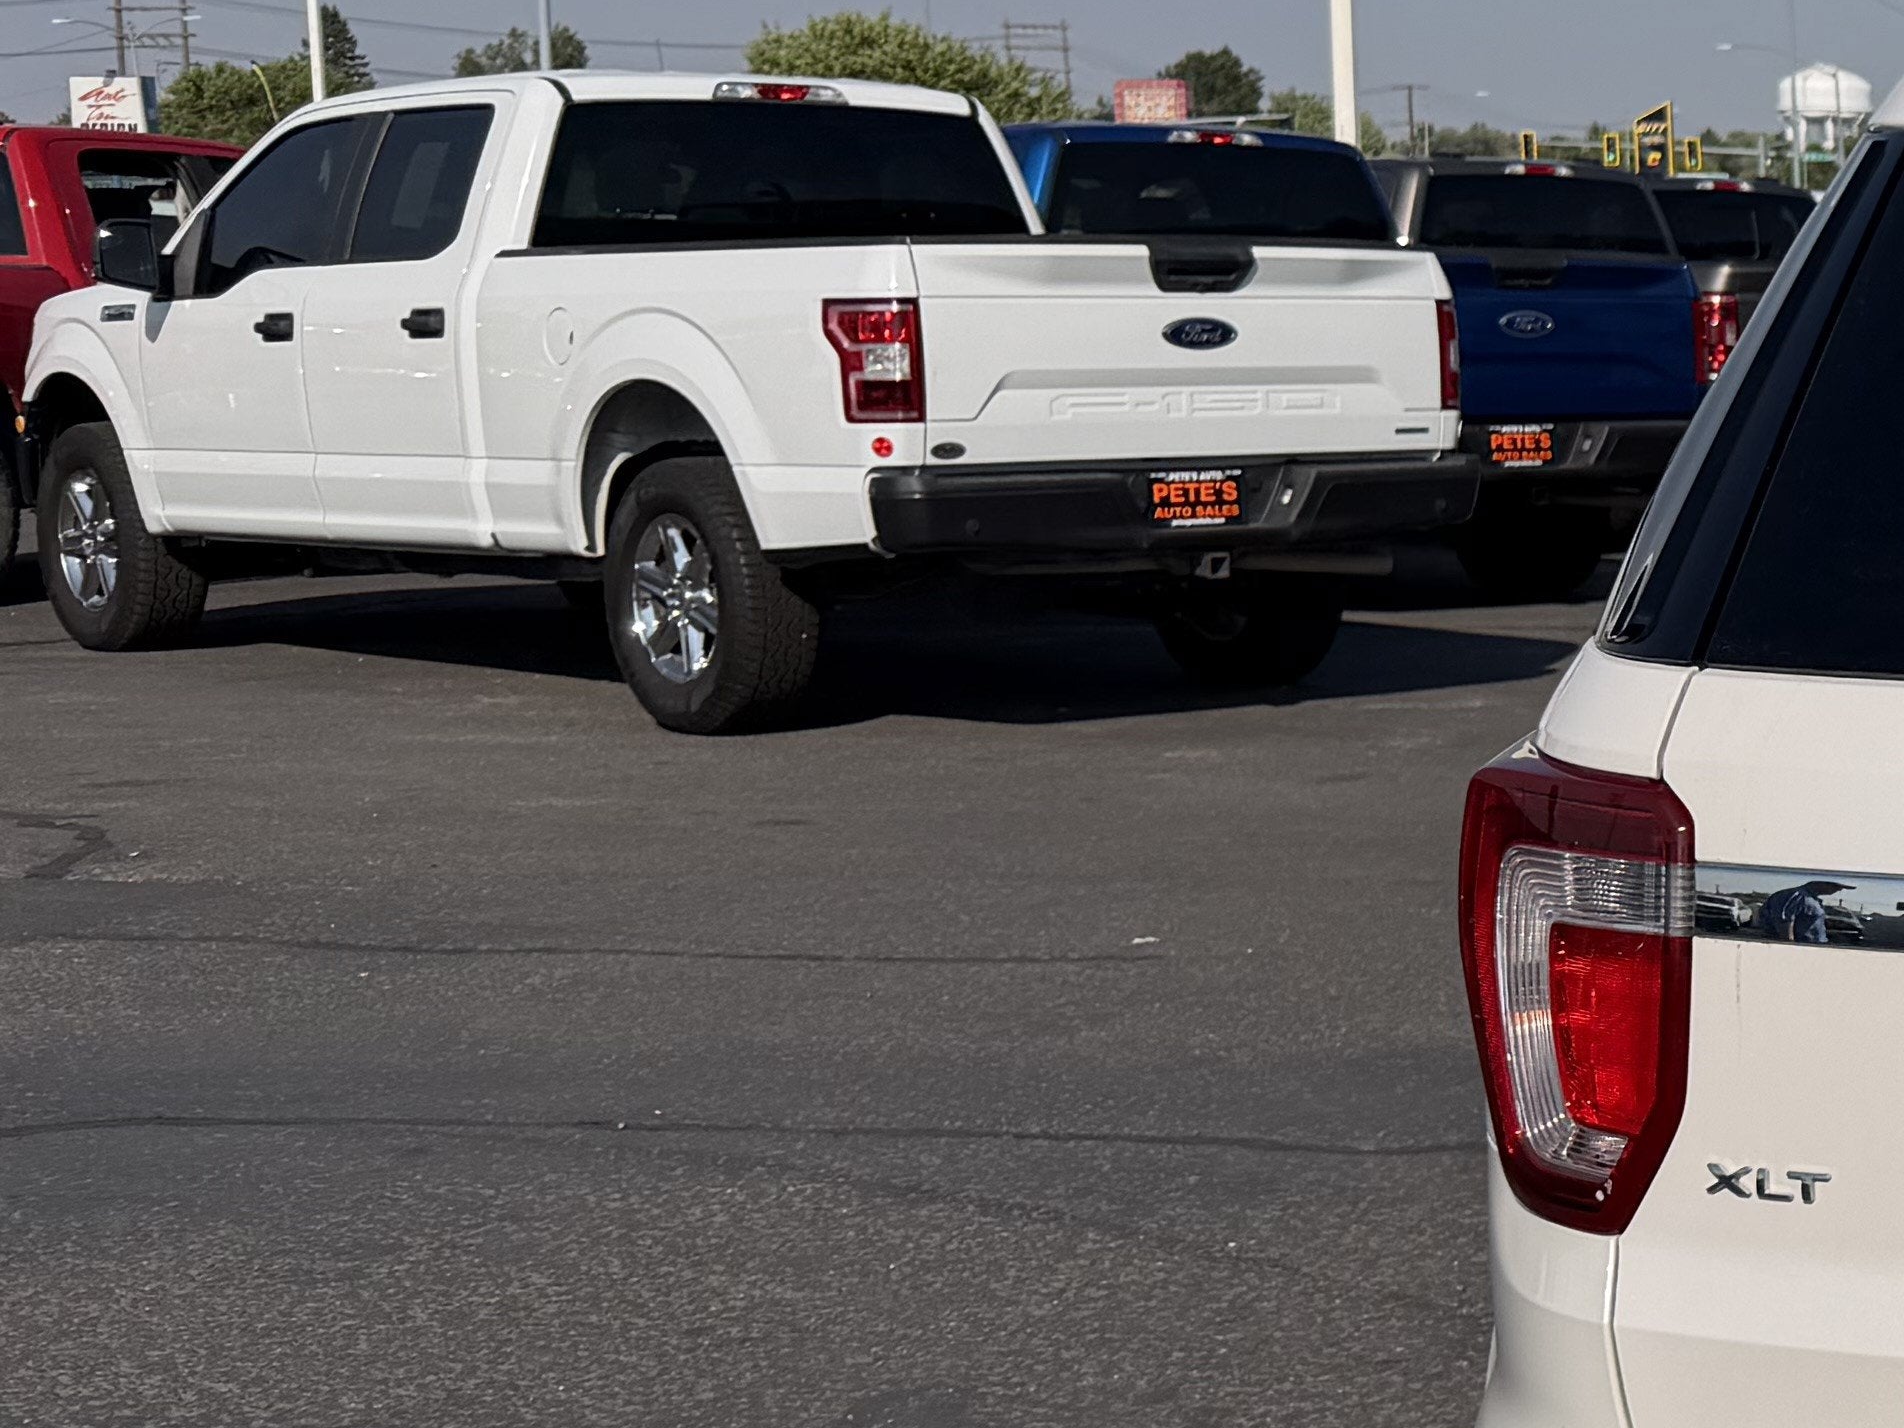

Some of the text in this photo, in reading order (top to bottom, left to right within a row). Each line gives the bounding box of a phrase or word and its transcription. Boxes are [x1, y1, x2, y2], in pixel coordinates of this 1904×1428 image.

[1050, 389, 1341, 420] F-150
[1491, 433, 1552, 450] PETE'S
[1153, 481, 1237, 503] PETE'S
[1154, 504, 1240, 519] AUTO SALES
[1706, 1163, 1832, 1204] XLT
